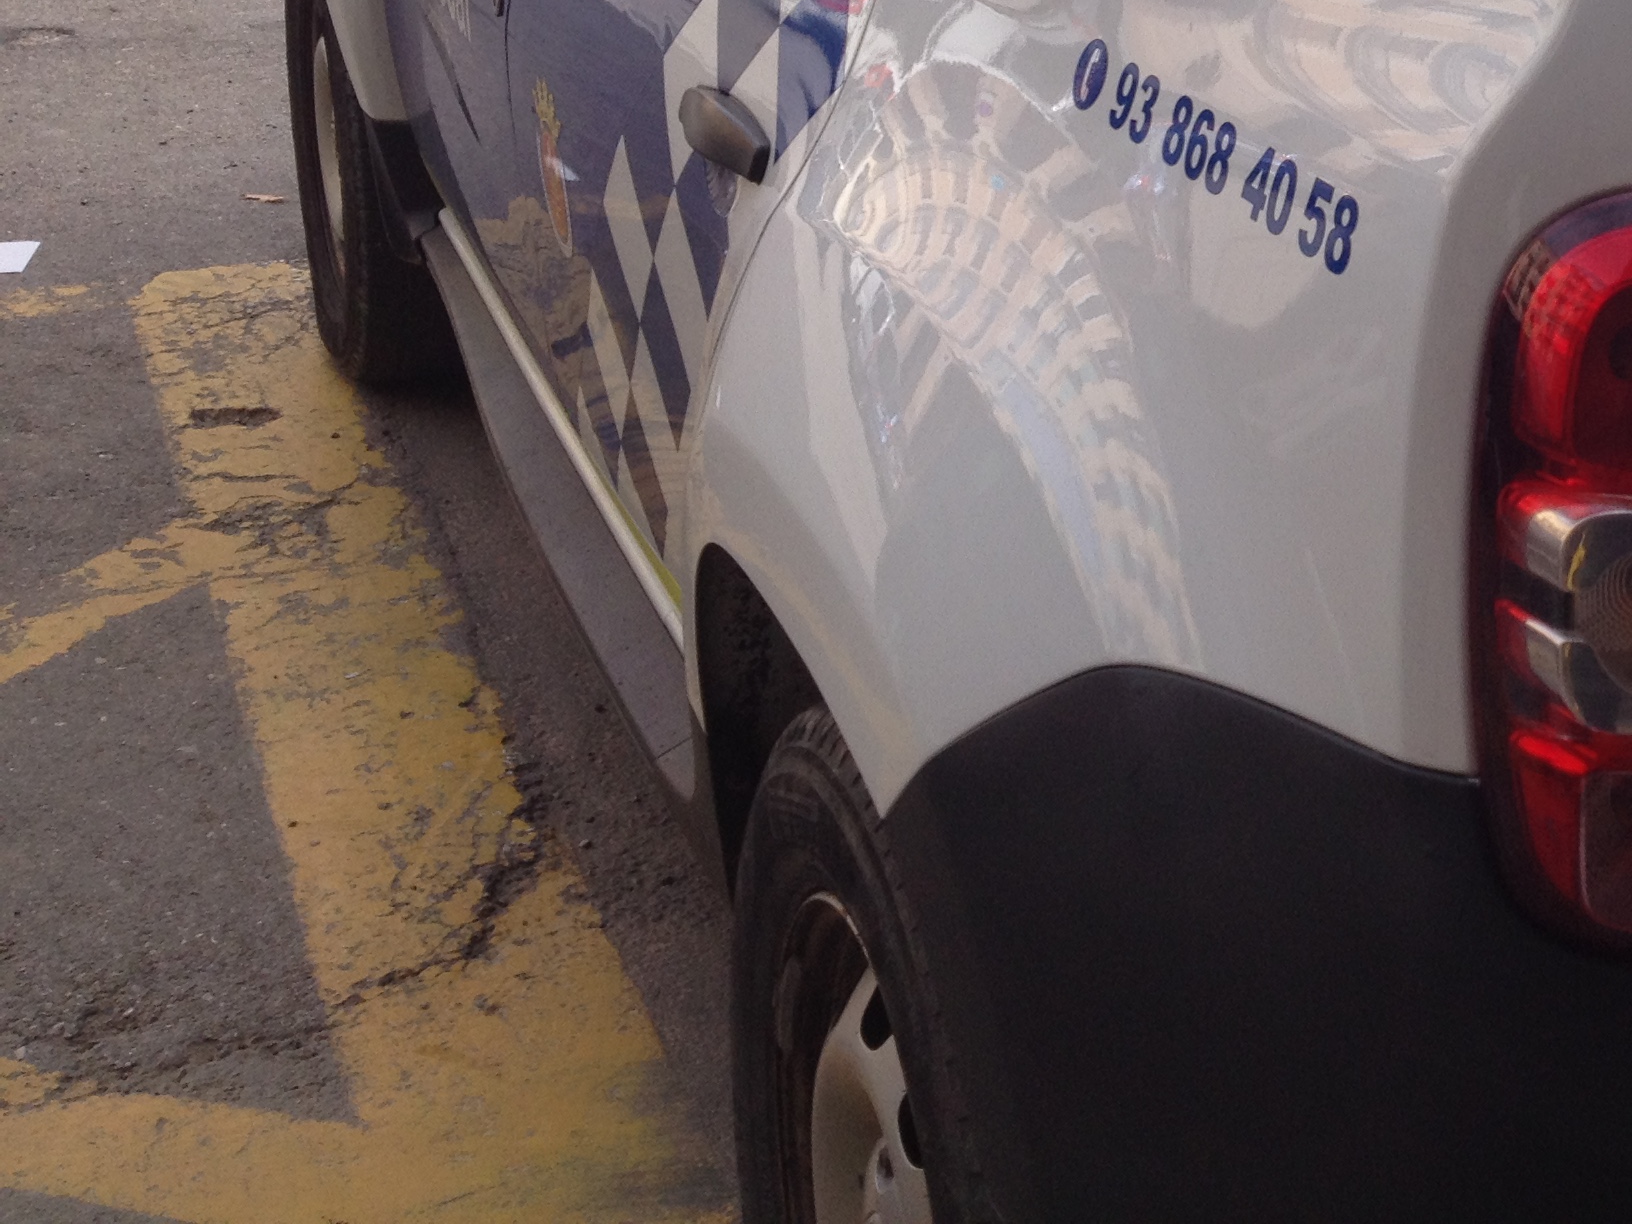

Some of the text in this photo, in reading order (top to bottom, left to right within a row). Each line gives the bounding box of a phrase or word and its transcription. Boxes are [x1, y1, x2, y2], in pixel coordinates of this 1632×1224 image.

[1108, 62, 1360, 275] 93 868 40 58
